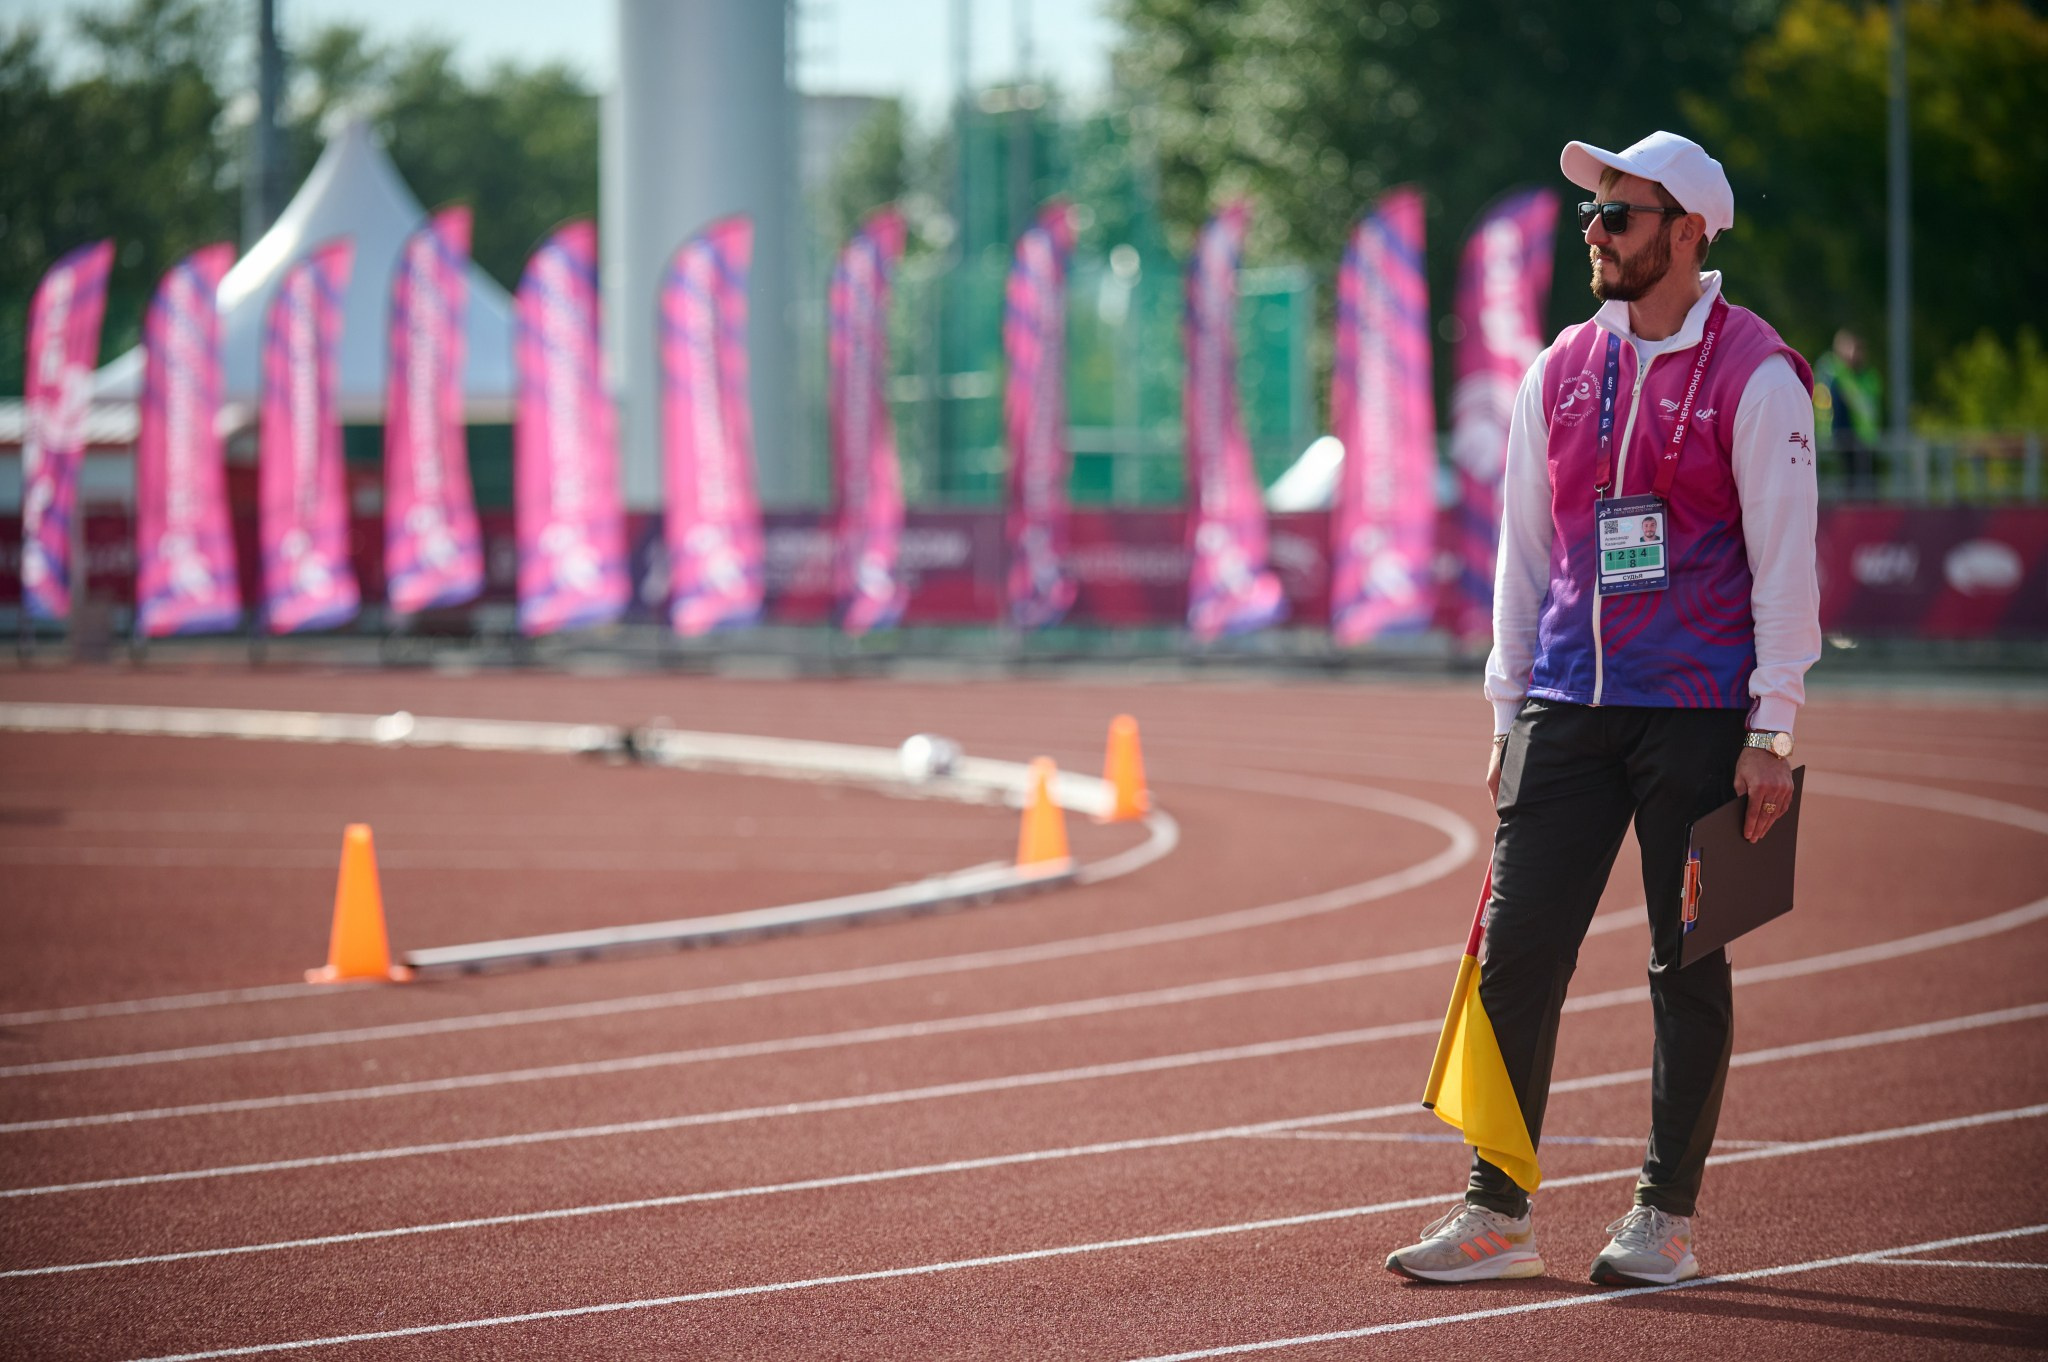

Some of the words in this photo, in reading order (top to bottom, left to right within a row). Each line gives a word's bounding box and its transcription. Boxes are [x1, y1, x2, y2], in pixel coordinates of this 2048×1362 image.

[1672, 424, 1685, 444] ПСБ
[1679, 368, 1703, 422] ЧЕМПИОНАТ
[1697, 331, 1716, 368] РОССИИ
[1607, 552, 1613, 561] 1
[1618, 551, 1625, 560] 2
[1629, 550, 1636, 559] 3
[1640, 548, 1647, 557] 4
[1629, 559, 1636, 568] 8
